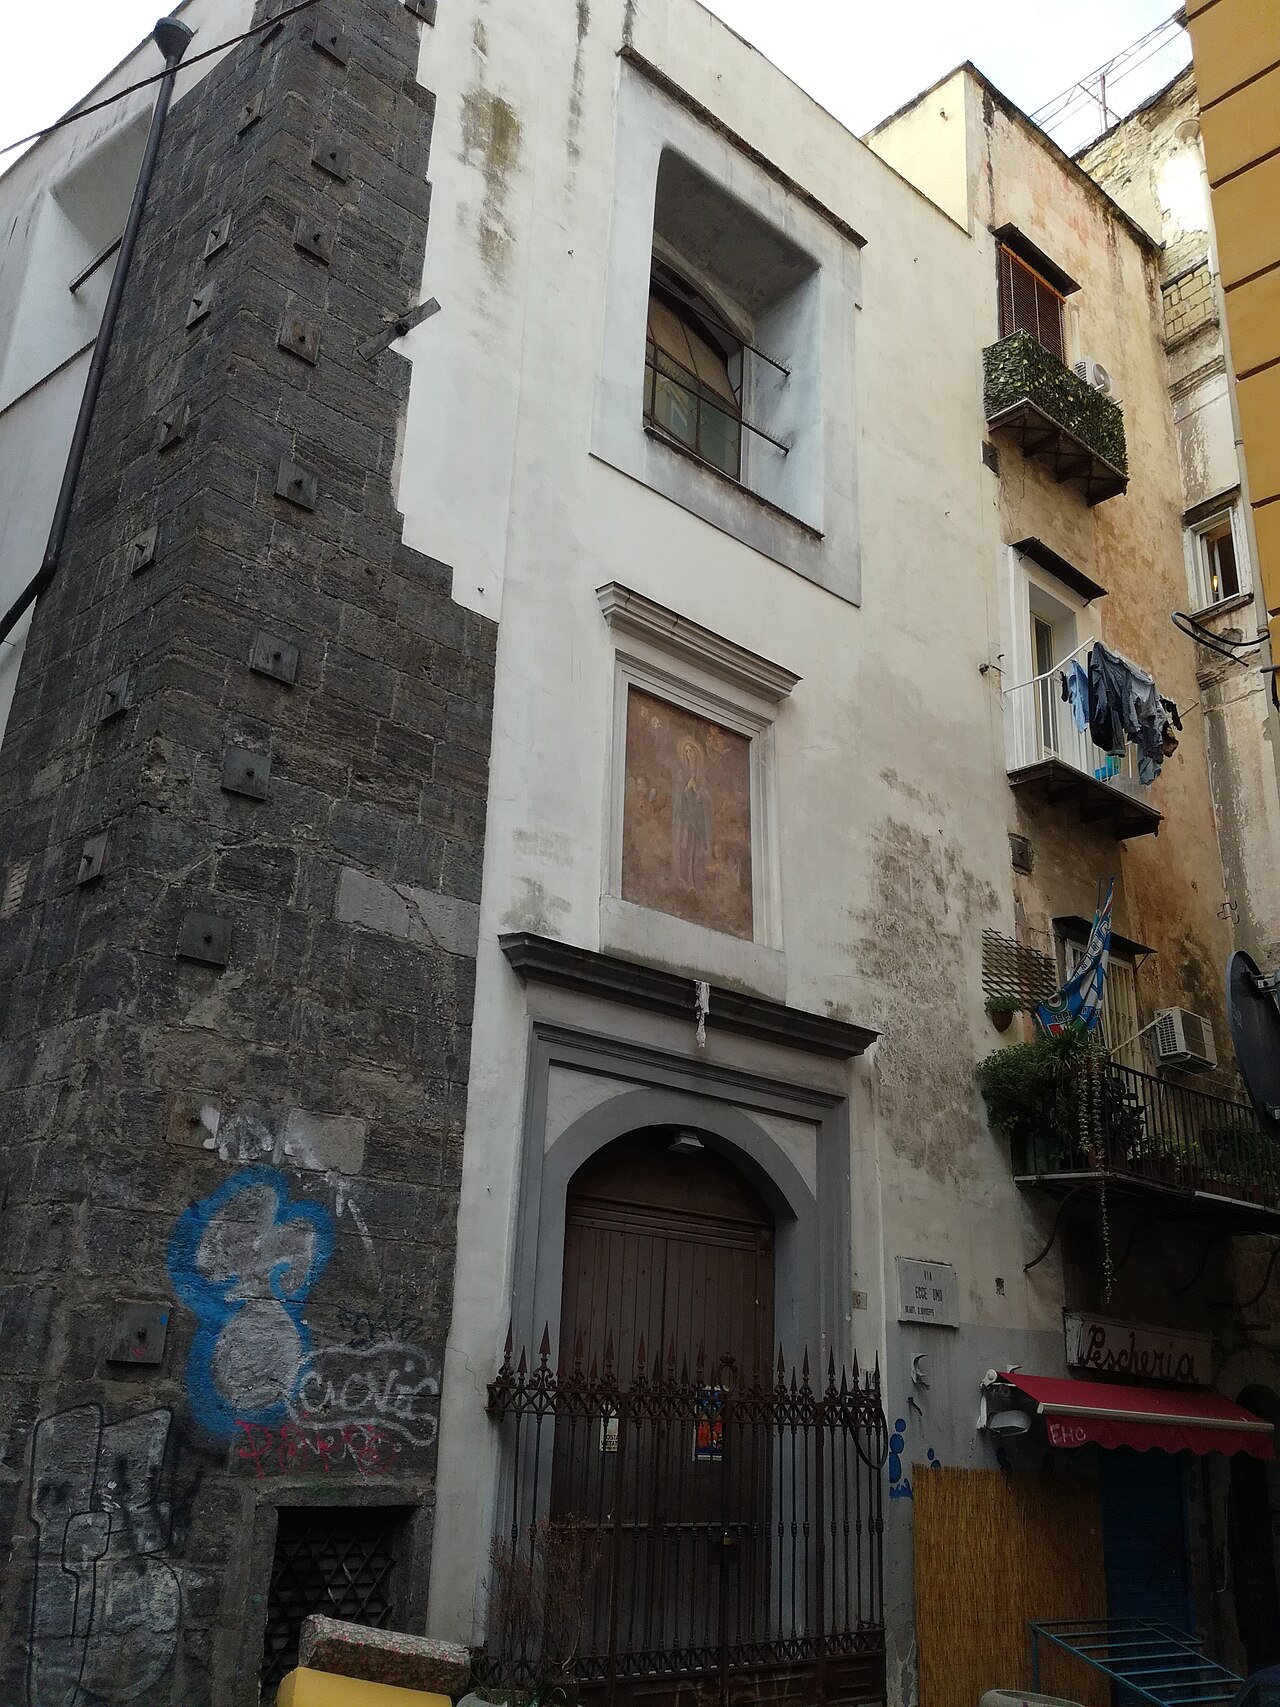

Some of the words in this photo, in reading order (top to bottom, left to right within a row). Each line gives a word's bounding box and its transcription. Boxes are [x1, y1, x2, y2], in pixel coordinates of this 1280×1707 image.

[923, 1270, 932, 1281] VIA
[915, 1285, 927, 1300] ECCE
[1079, 1323, 1200, 1383] Pescheria
